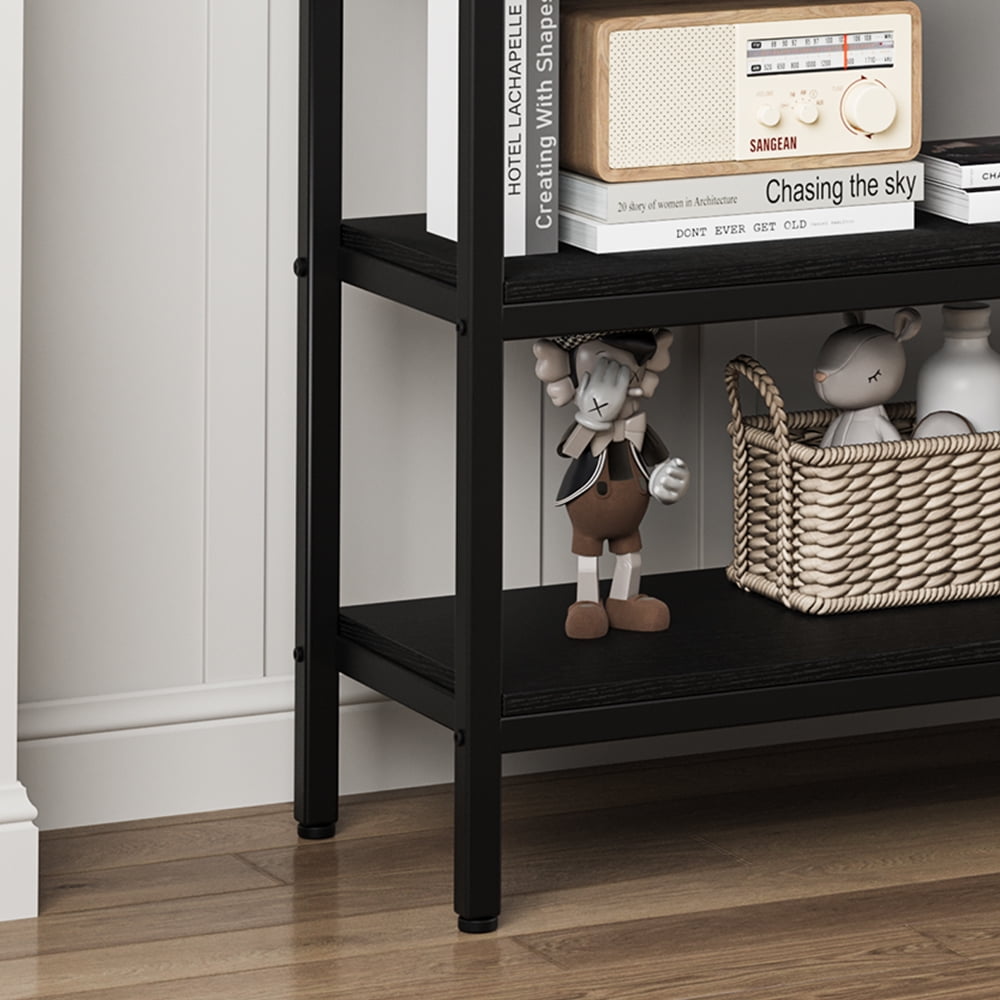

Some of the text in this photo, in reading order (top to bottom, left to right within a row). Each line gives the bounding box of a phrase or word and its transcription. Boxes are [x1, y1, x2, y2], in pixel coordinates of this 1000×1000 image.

[507, 4, 522, 196] HOTEL LACHAPELLE
[535, 78, 553, 130] With
[749, 135, 797, 153] SANGEAN
[535, 135, 557, 230] Creating
[765, 170, 917, 207] Chasing the sky
[617, 195, 738, 213] 20 story of women in Architecture
[676, 227, 708, 239] DONT
[715, 224, 746, 236] EVER
[753, 222, 777, 234] GET
[783, 219, 807, 231] OLD
